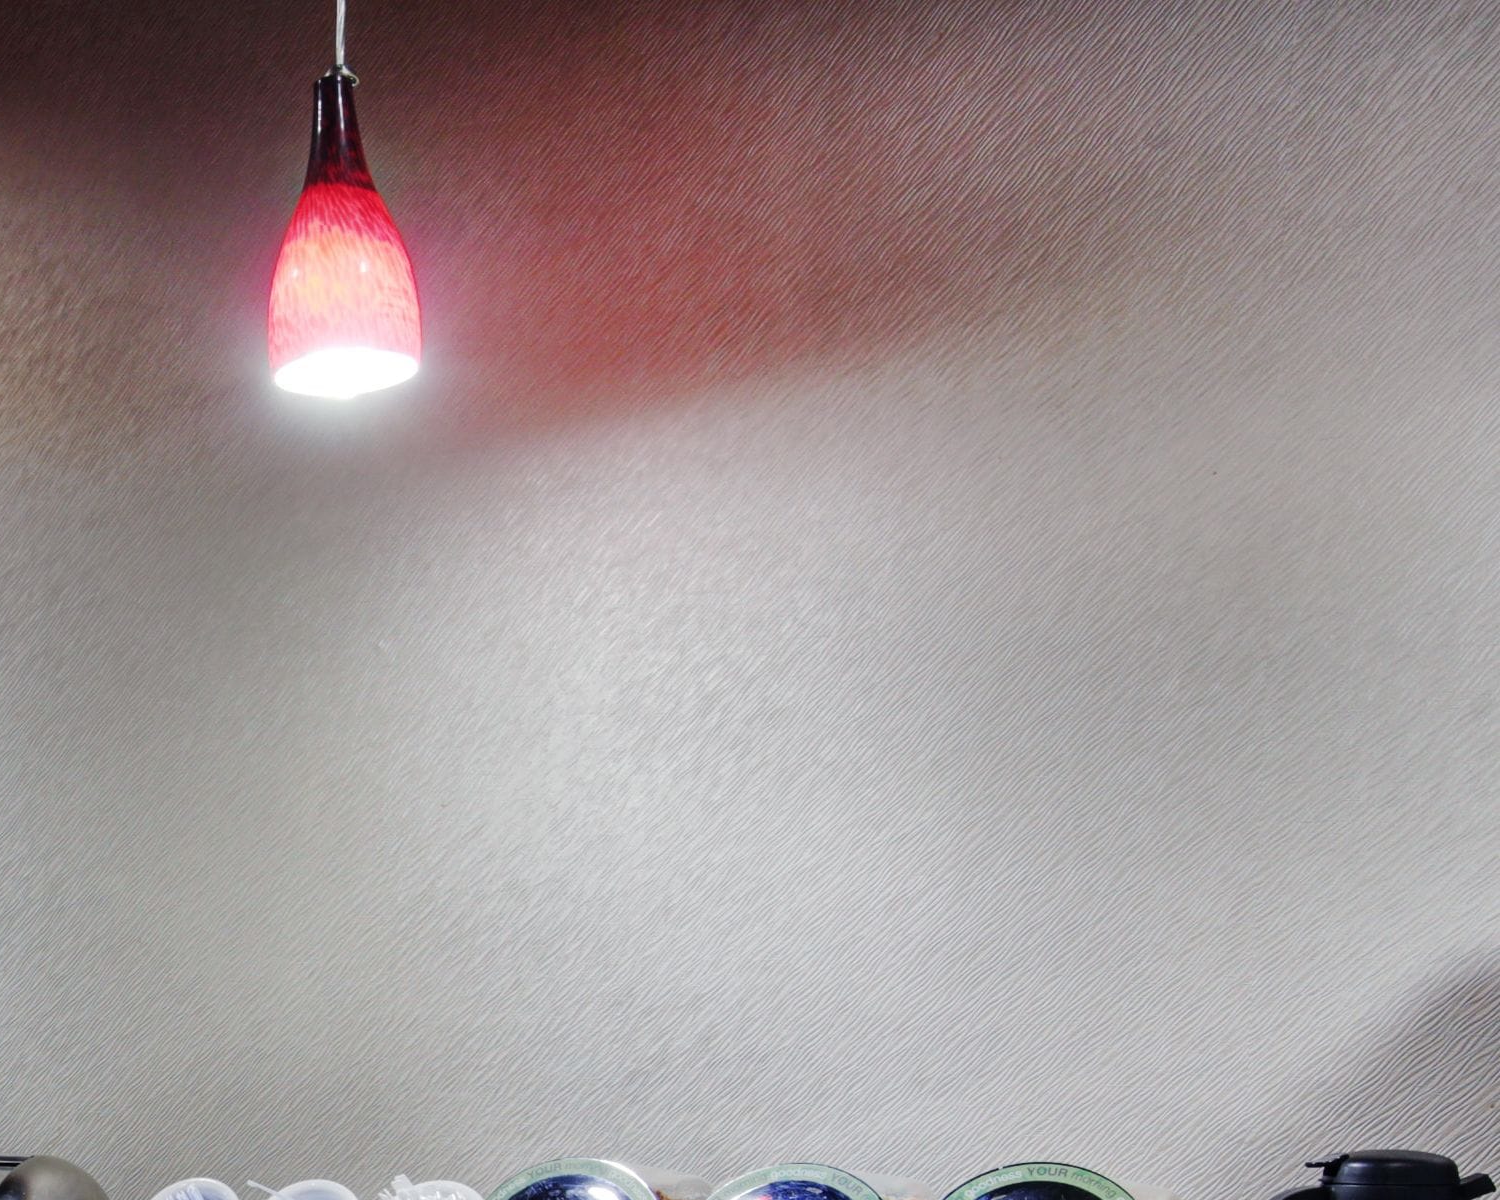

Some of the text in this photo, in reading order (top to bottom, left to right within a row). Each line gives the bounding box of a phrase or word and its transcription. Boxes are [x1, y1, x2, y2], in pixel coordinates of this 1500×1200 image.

[527, 1163, 562, 1179] YOUR
[770, 1168, 827, 1181] goodness
[964, 1169, 1022, 1198] goodness
[1027, 1166, 1068, 1178] YOUR
[1070, 1172, 1117, 1199] morning
[831, 1172, 864, 1197] YOUR
